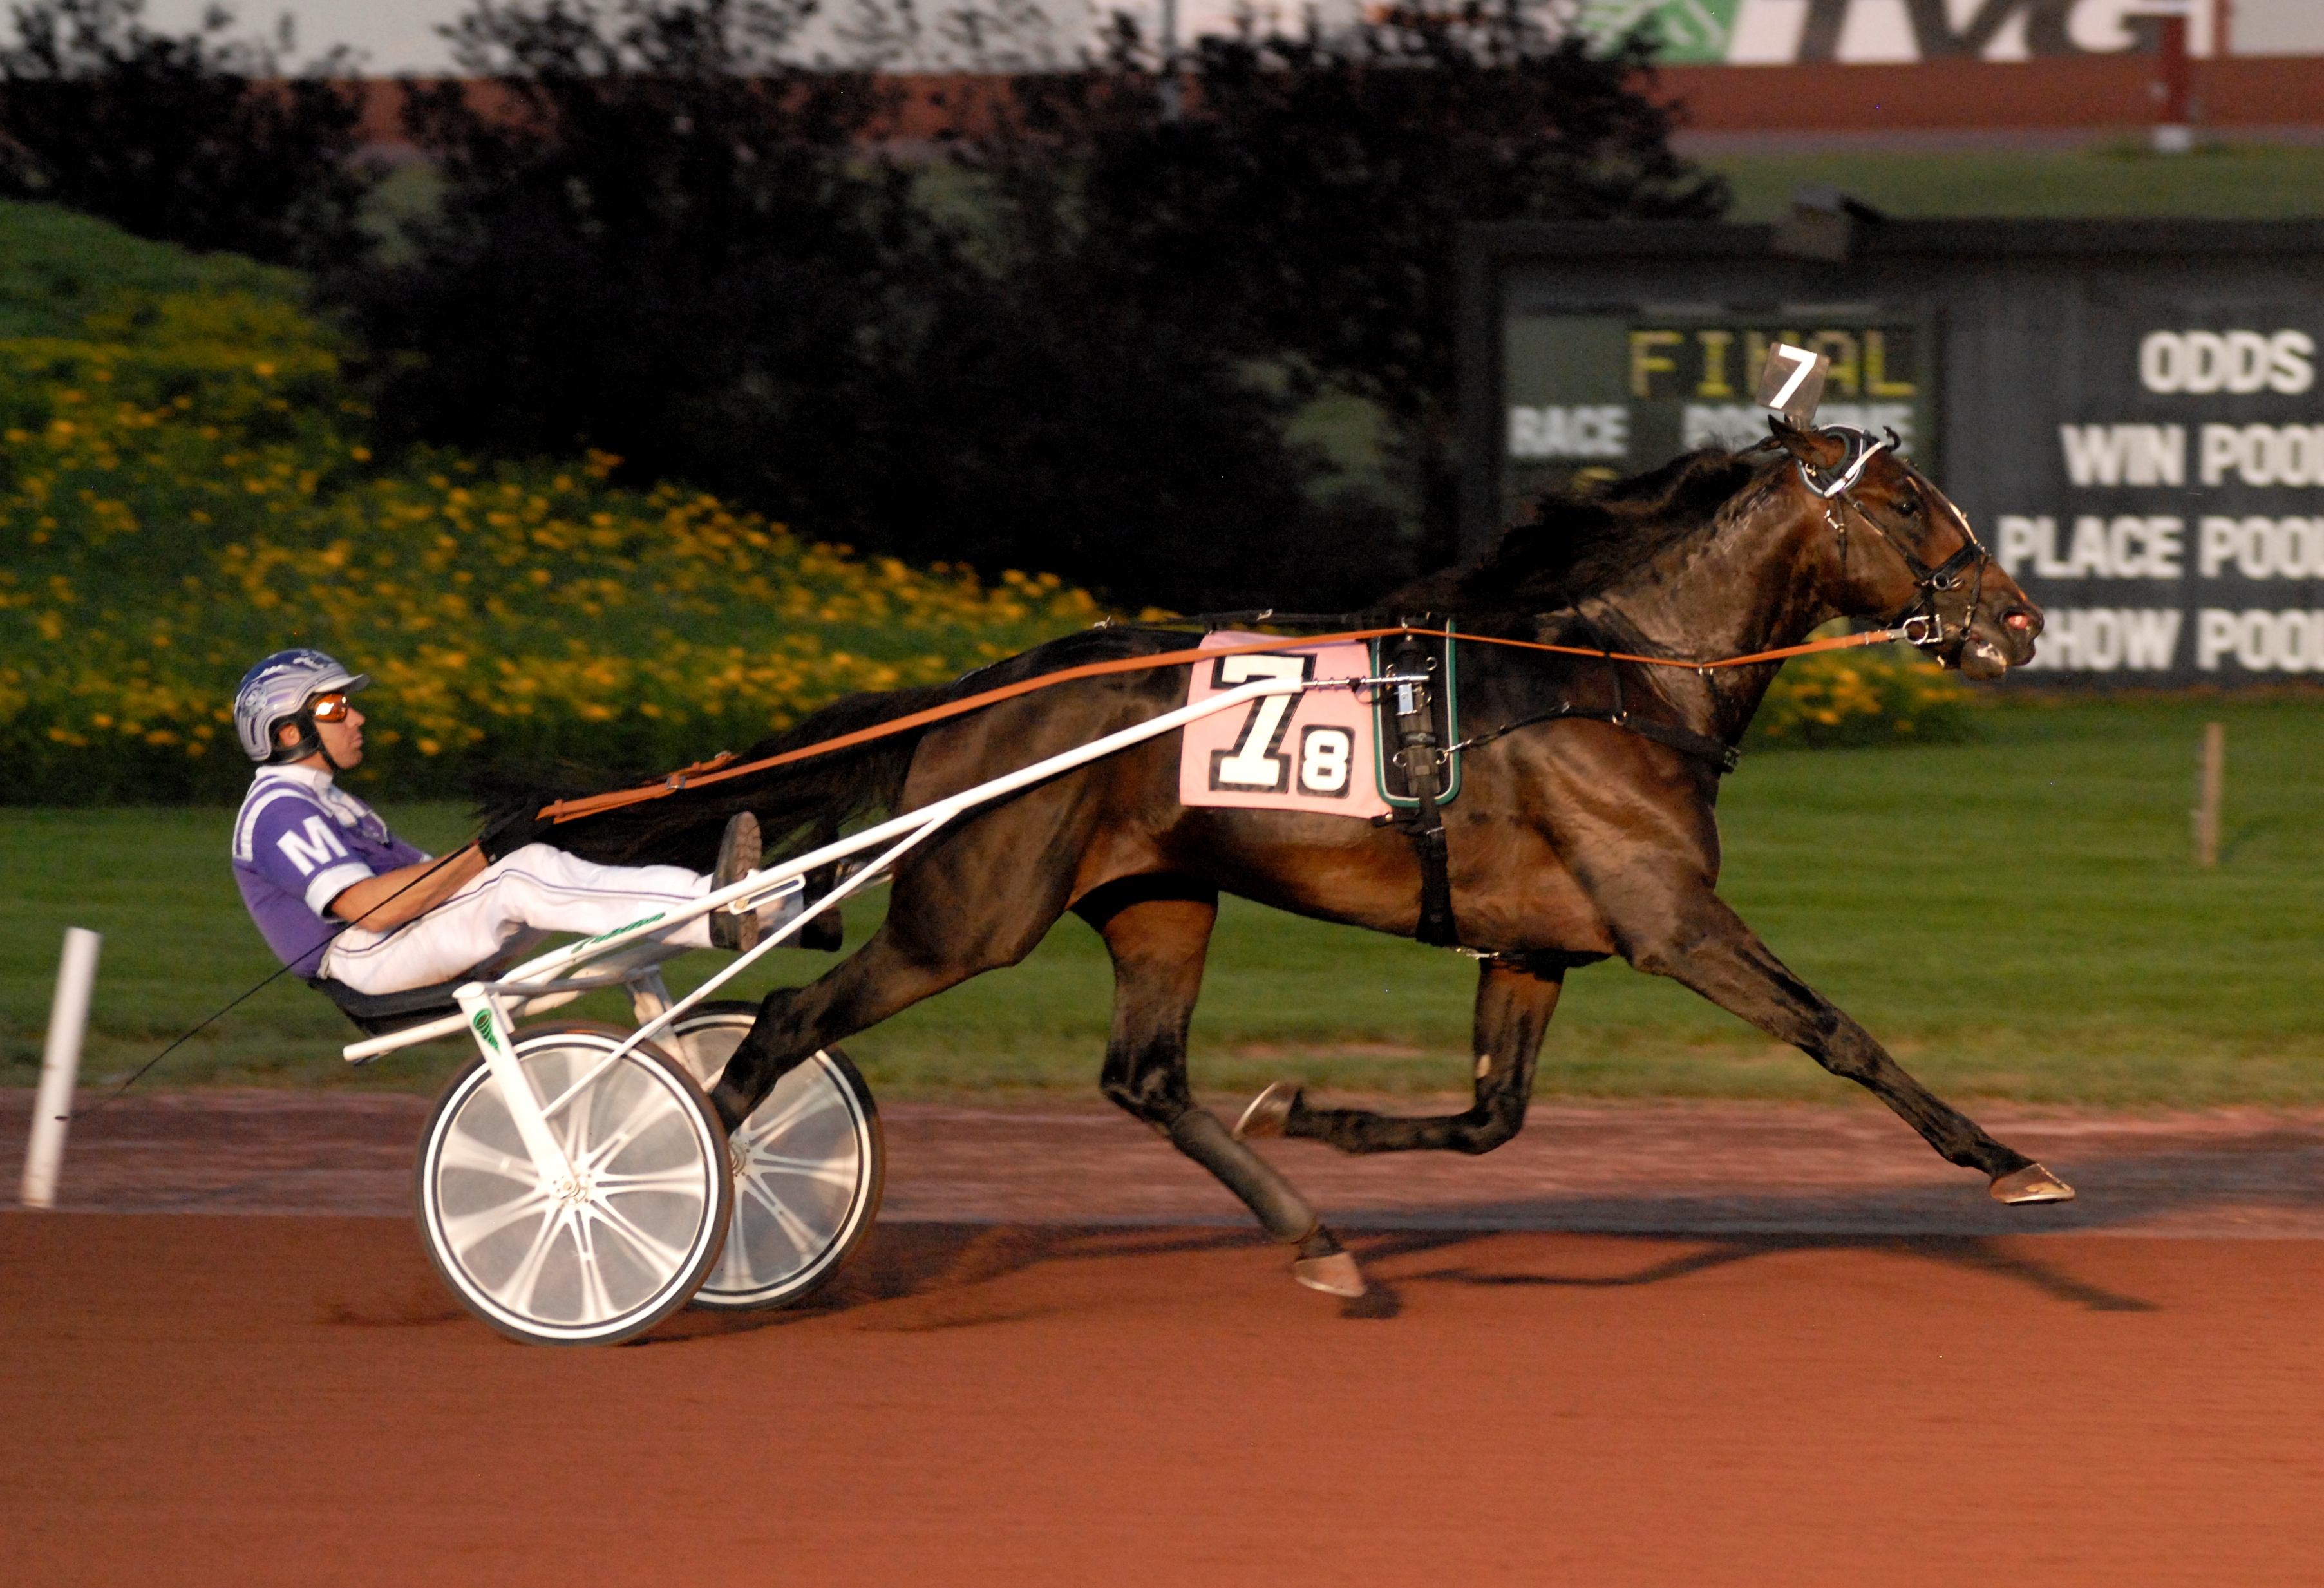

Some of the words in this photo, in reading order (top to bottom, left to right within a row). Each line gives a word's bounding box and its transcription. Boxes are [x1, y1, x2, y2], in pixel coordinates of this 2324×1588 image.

[1770, 343, 1817, 409] 7
[2140, 330, 2315, 394] ODDS
[2061, 424, 2186, 487] WIN
[2200, 424, 2324, 487] POO
[1998, 516, 2184, 578] PLACE
[2199, 516, 2324, 578] POO
[2197, 609, 2324, 671] POO
[1209, 652, 1317, 793] 7
[1297, 725, 1354, 799] 8
[276, 815, 348, 877] M
